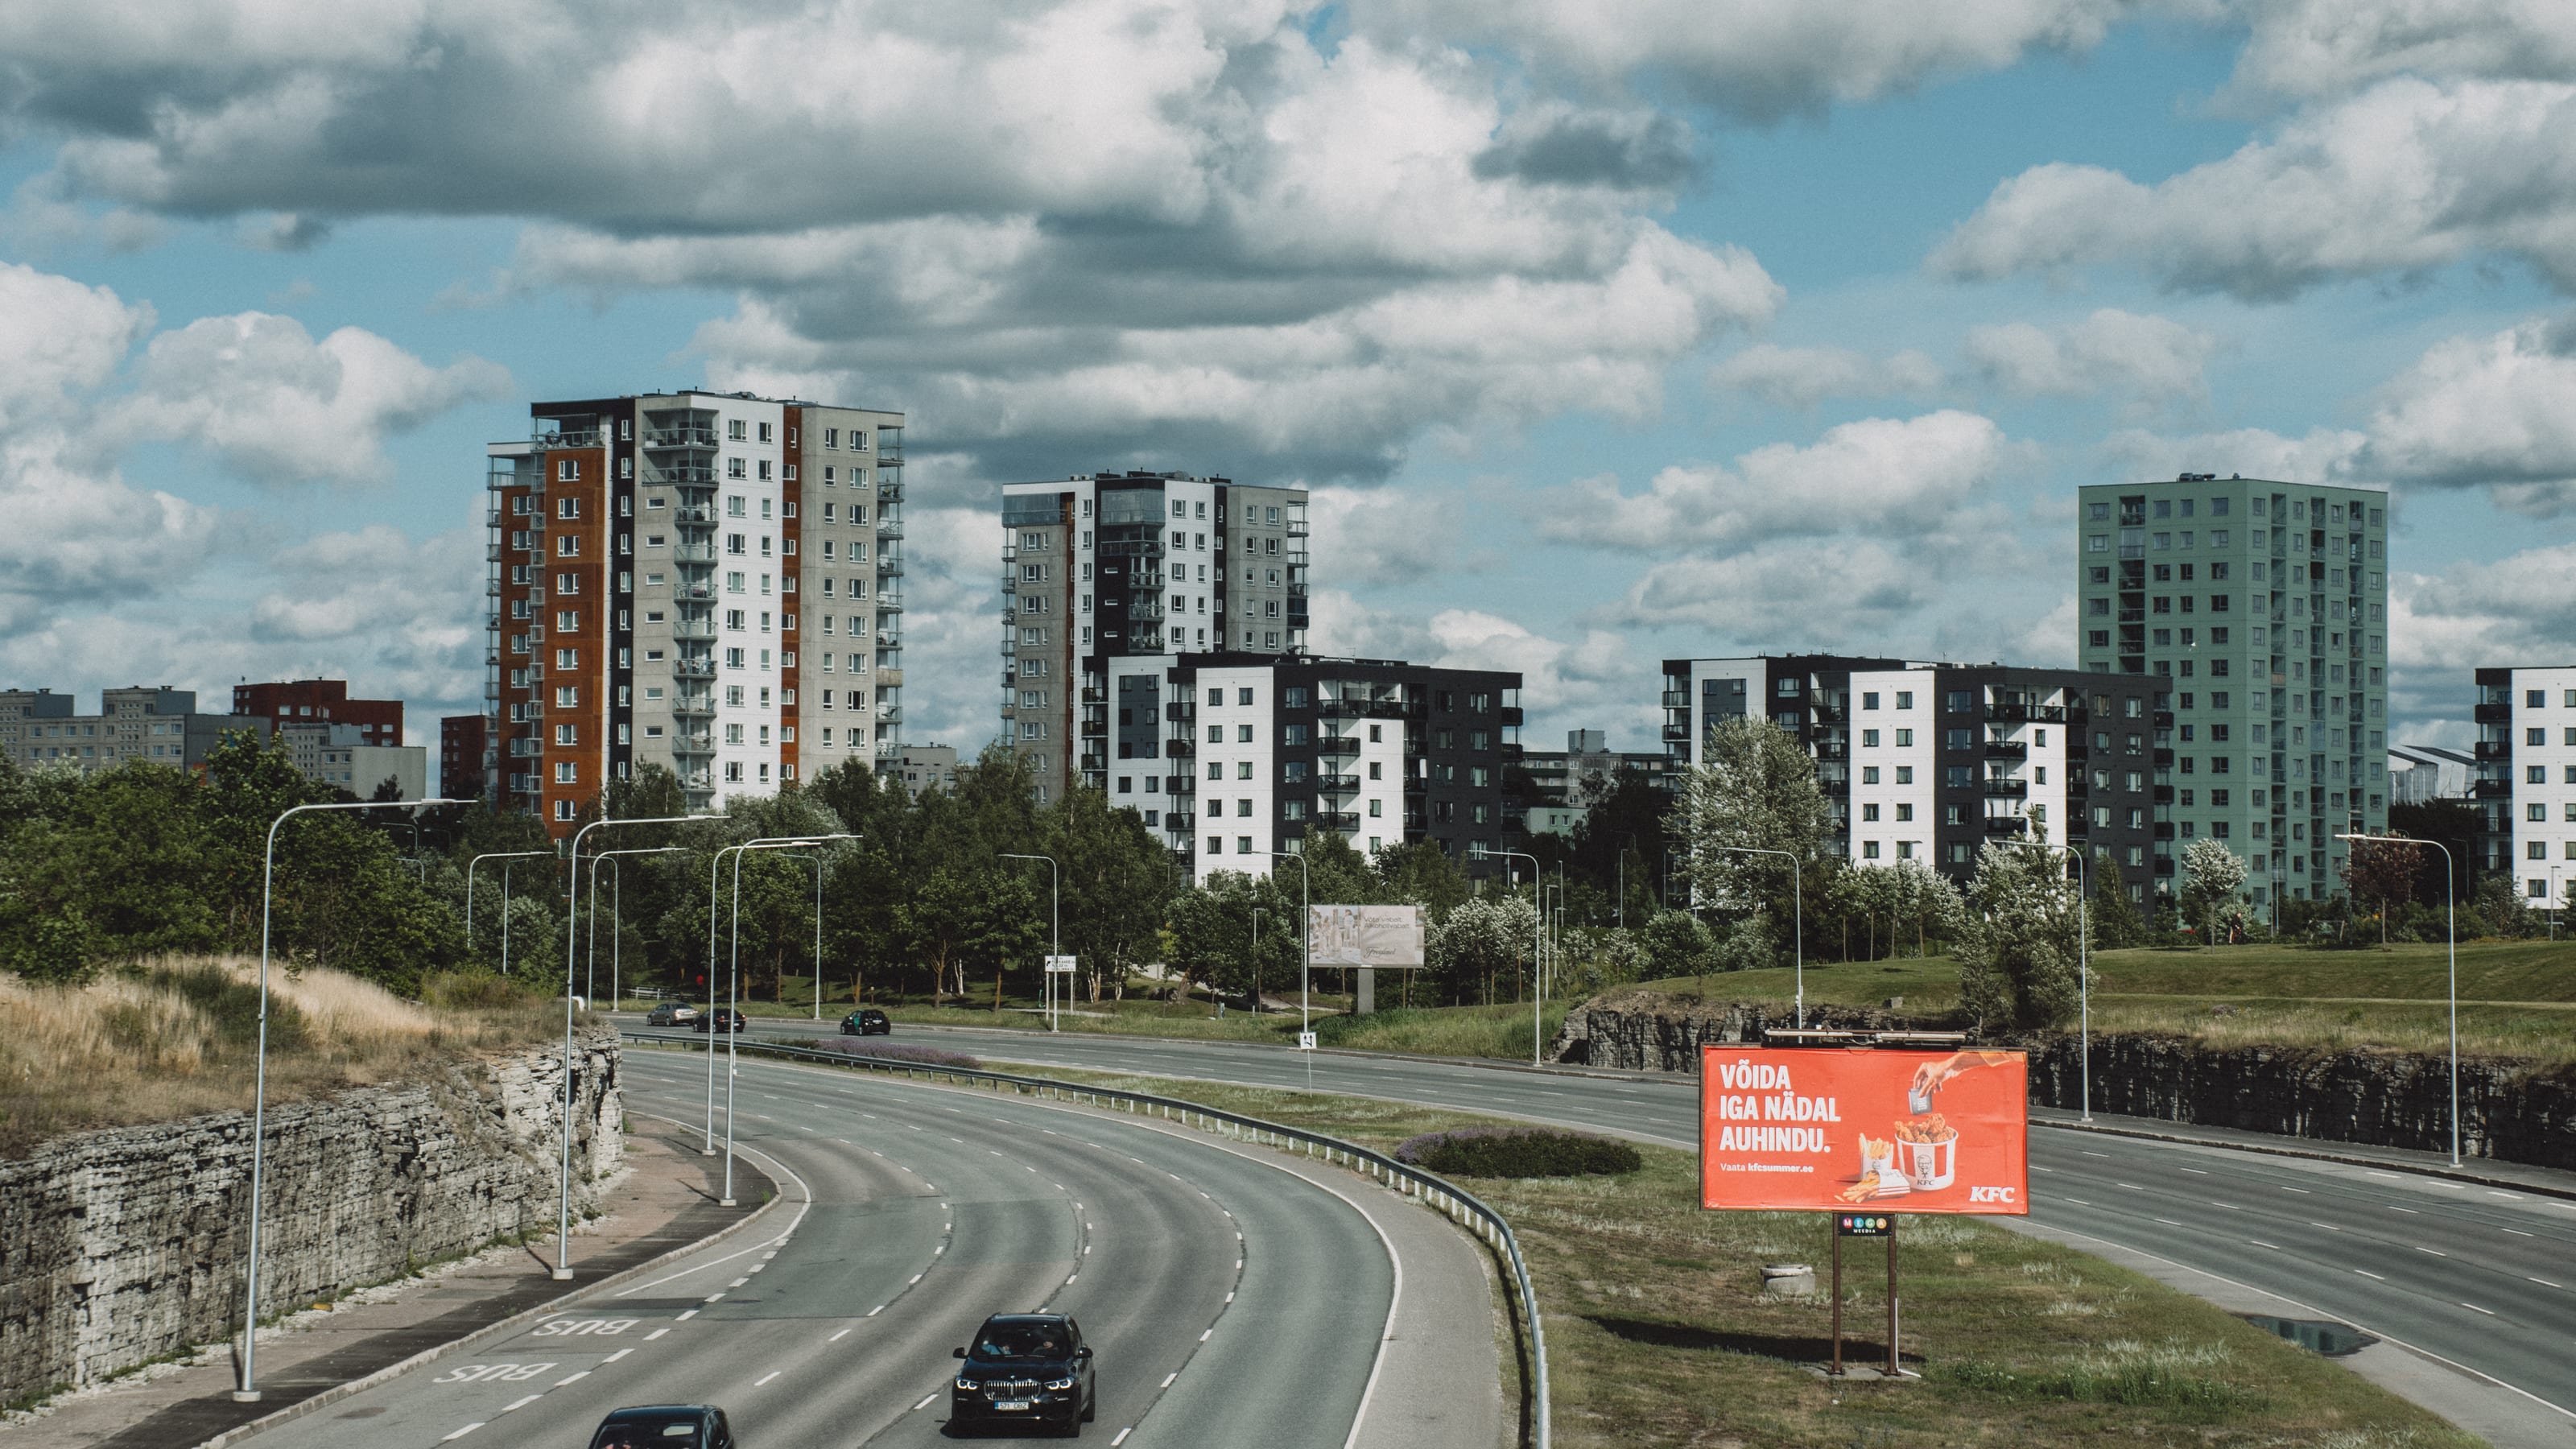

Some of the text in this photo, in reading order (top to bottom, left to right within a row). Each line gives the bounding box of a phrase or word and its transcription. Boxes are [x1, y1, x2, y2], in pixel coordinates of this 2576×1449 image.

[1719, 1059, 1791, 1089] VÕIDA
[1719, 1091, 1841, 1122] IGA NÄDAL
[1719, 1126, 1831, 1153] AUHINDU.
[1720, 1162, 1814, 1174] Vaata kfcsummer.ee
[1969, 1186, 2015, 1203] KFC
[1843, 1219, 1885, 1227] MEGA
[532, 1319, 641, 1335] BUS
[432, 1362, 559, 1383] BUS
